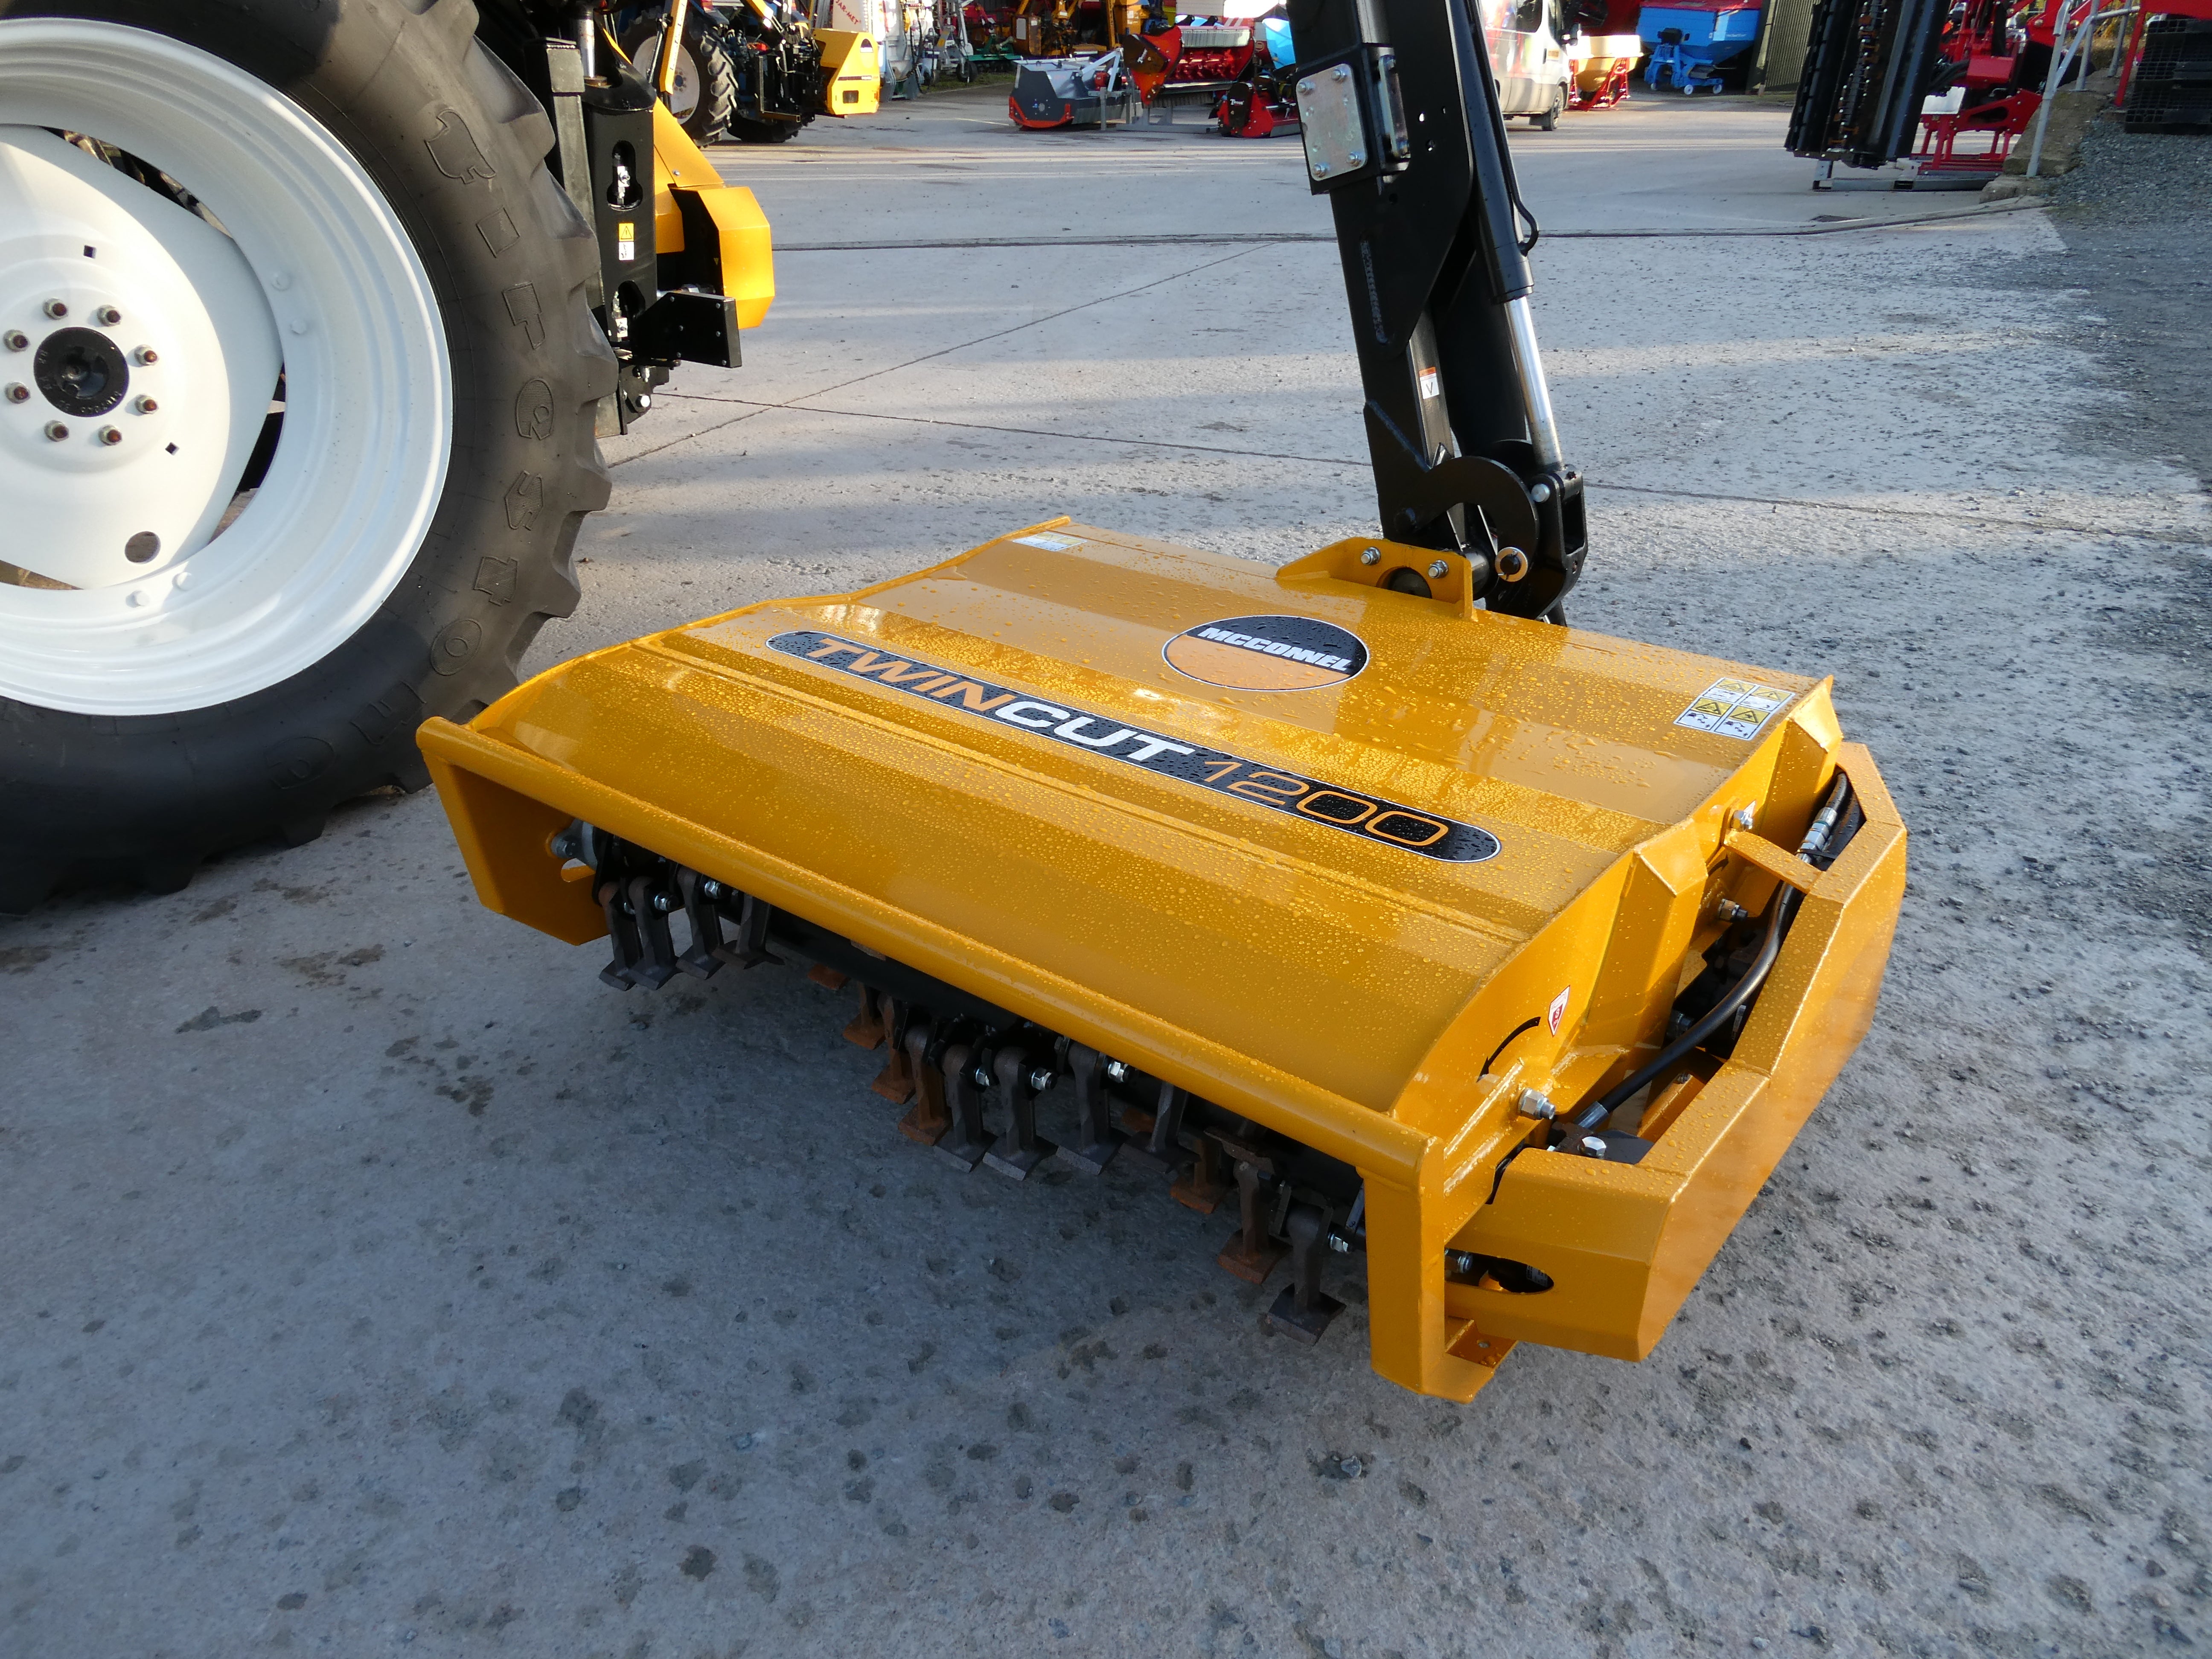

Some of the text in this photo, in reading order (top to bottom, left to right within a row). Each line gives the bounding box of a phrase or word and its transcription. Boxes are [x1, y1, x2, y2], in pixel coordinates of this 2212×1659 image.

[835, 0, 859, 25] JAR-MET
[1197, 627, 1351, 671] MCCONNEL
[807, 638, 1448, 846] TWINCUT 1200
